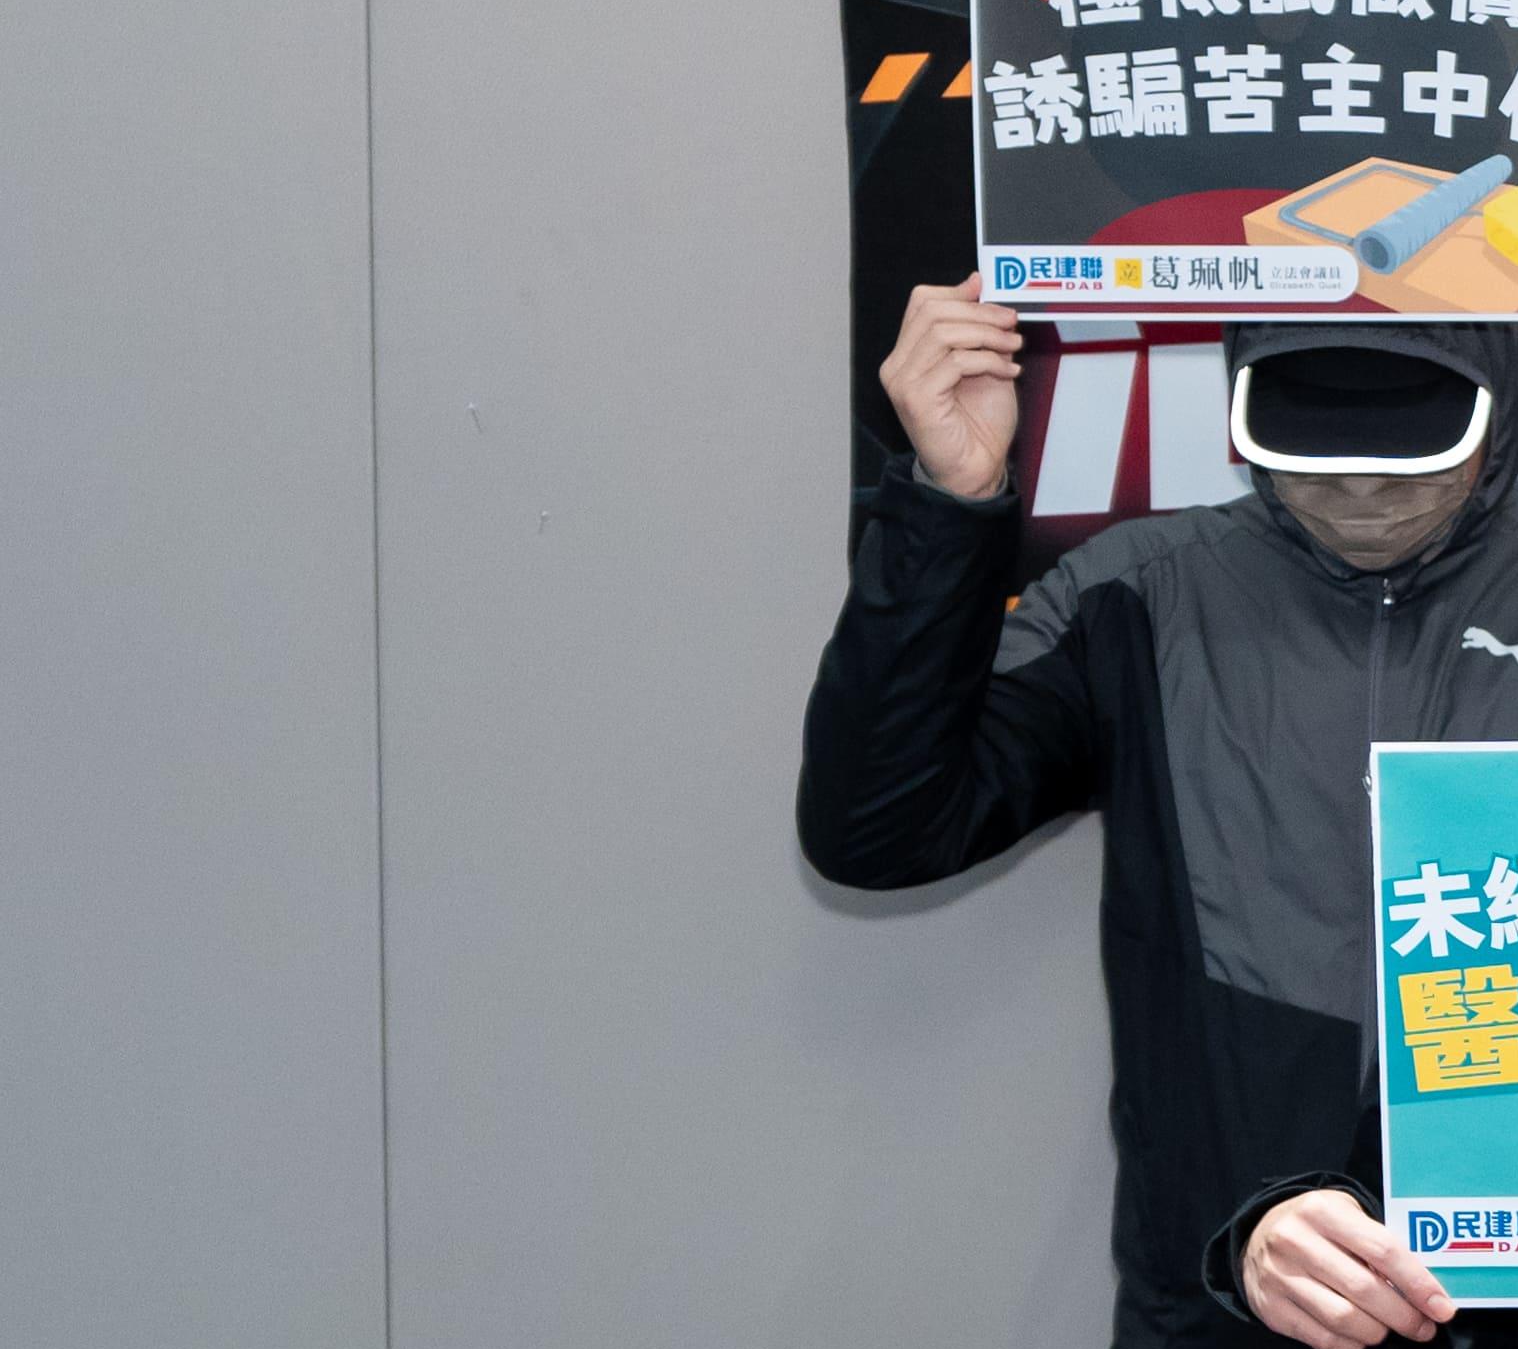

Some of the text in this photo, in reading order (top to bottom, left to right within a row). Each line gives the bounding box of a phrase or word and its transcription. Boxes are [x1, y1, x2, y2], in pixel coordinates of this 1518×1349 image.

[1030, 256, 1103, 279] 民建聯
[1149, 256, 1263, 290] 葛珮帆
[1065, 282, 1103, 290] DAB
